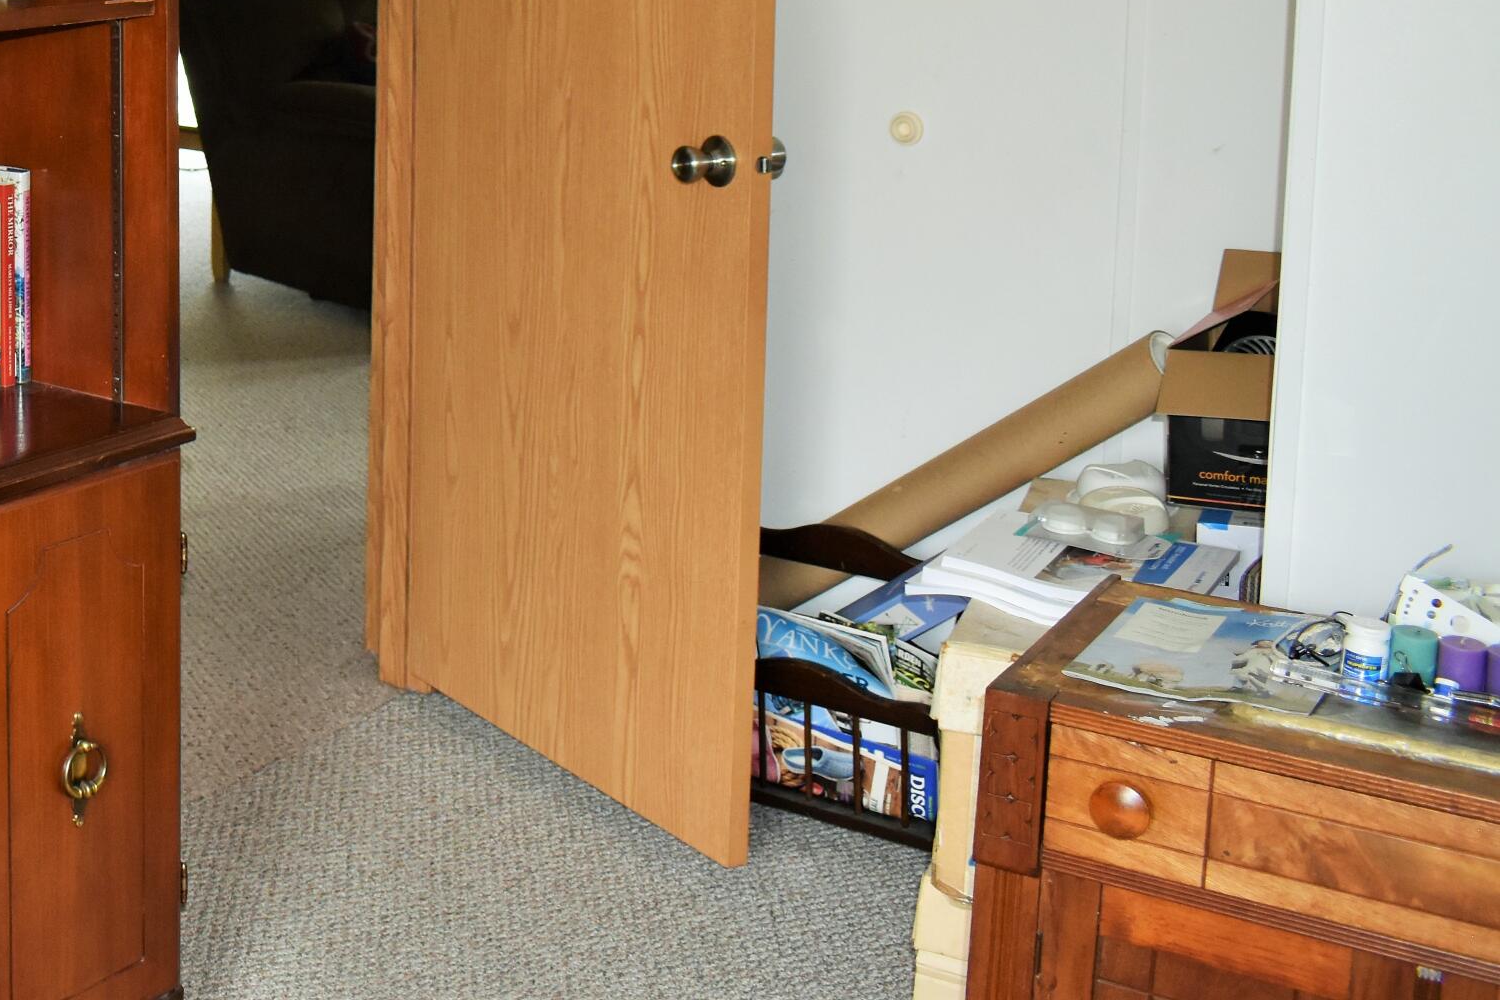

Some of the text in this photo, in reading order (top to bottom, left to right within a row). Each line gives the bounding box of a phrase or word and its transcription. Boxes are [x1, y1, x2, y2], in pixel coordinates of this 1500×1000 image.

[7, 195, 15, 257] THE MIRROR
[1199, 471, 1268, 485] comfort ma
